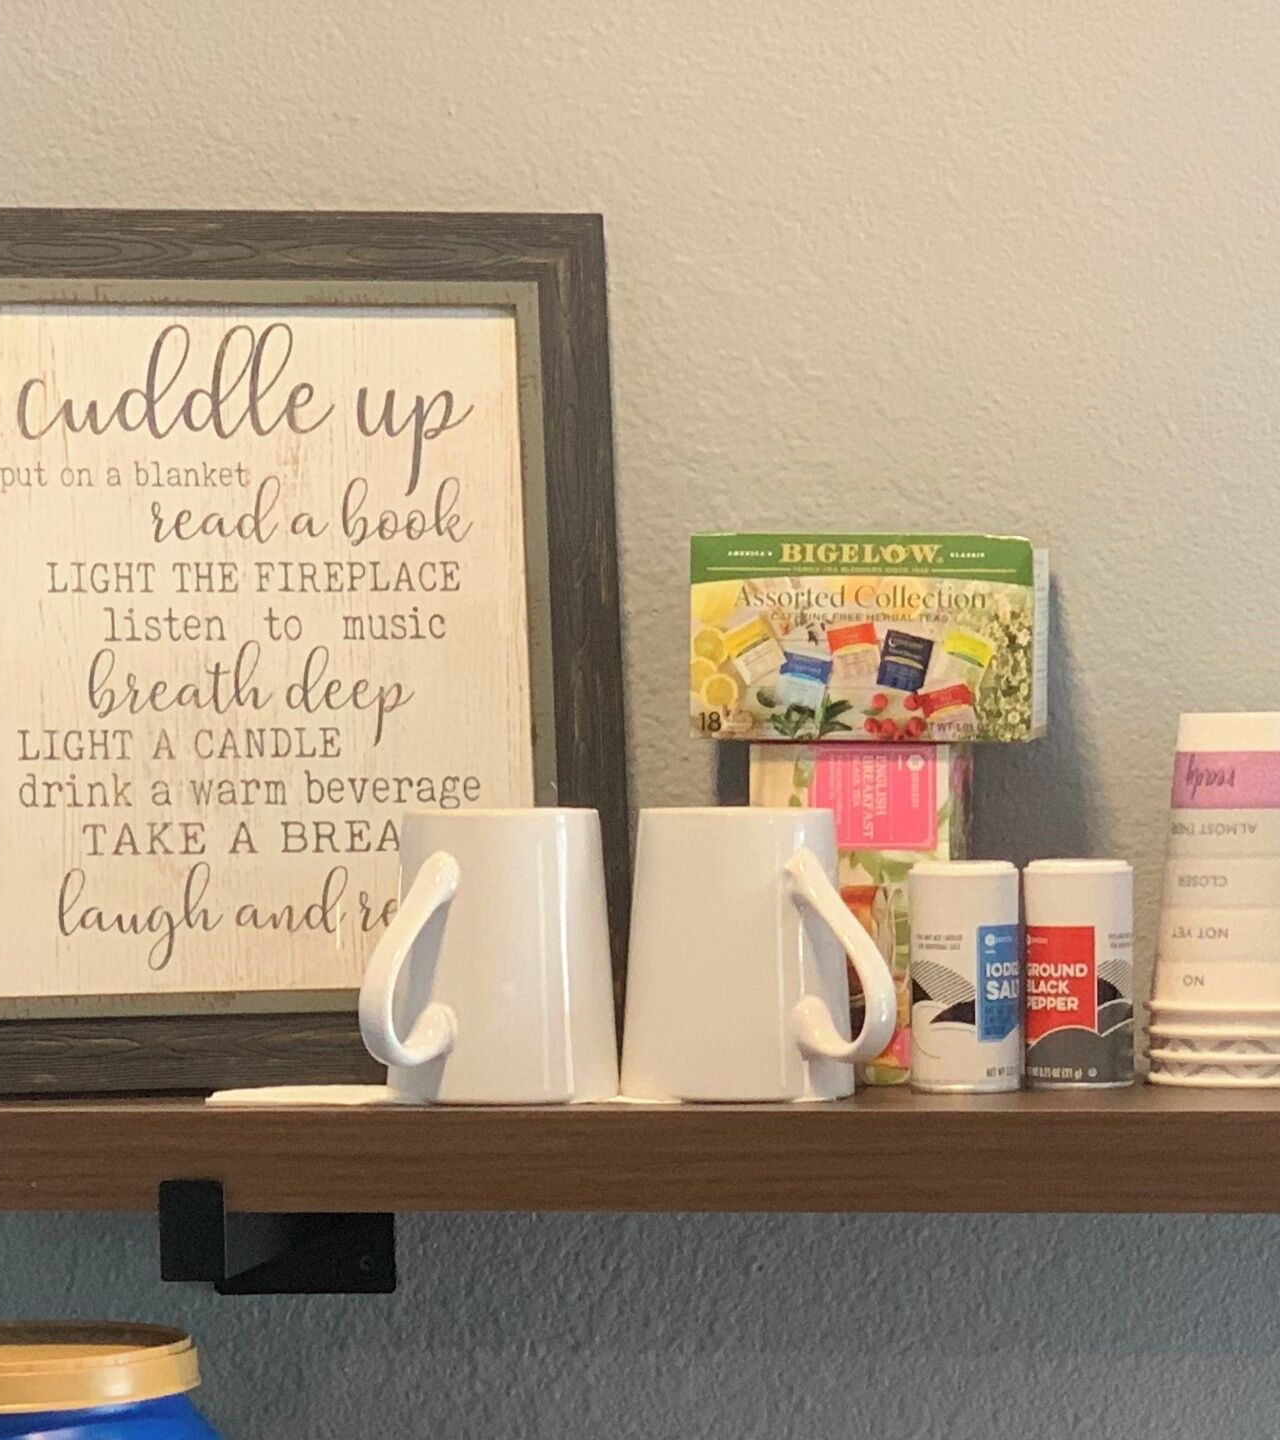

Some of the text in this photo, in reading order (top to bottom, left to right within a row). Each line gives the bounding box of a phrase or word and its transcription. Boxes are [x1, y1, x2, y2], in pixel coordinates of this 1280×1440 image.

[16, 322, 475, 496] cuddle up
[0, 460, 249, 493] put on a blanket
[150, 476, 474, 546] read a book
[779, 542, 939, 564] BIGELOW
[46, 561, 462, 594] LIGHT THE FIREPLACE
[733, 585, 987, 609] Assorted Collection
[103, 606, 447, 642] listen to music
[832, 613, 863, 622] FREE
[866, 613, 914, 622] HERBAL
[87, 640, 416, 747] breath deep
[699, 711, 722, 732] 18
[17, 727, 343, 762] LIGHT A CANDLE
[19, 770, 482, 810] drink a warm beverage
[875, 755, 887, 816] ENGLISH
[1185, 753, 1235, 801] ready
[862, 755, 875, 839] BREAKFAST
[82, 820, 401, 858] TAKE A BREA
[1199, 822, 1257, 838] ALMOST
[1177, 875, 1228, 888] CLOSER
[58, 860, 224, 971] laugh
[234, 864, 347, 933] and
[1197, 926, 1229, 939] NOT
[1182, 974, 1204, 987] NO
